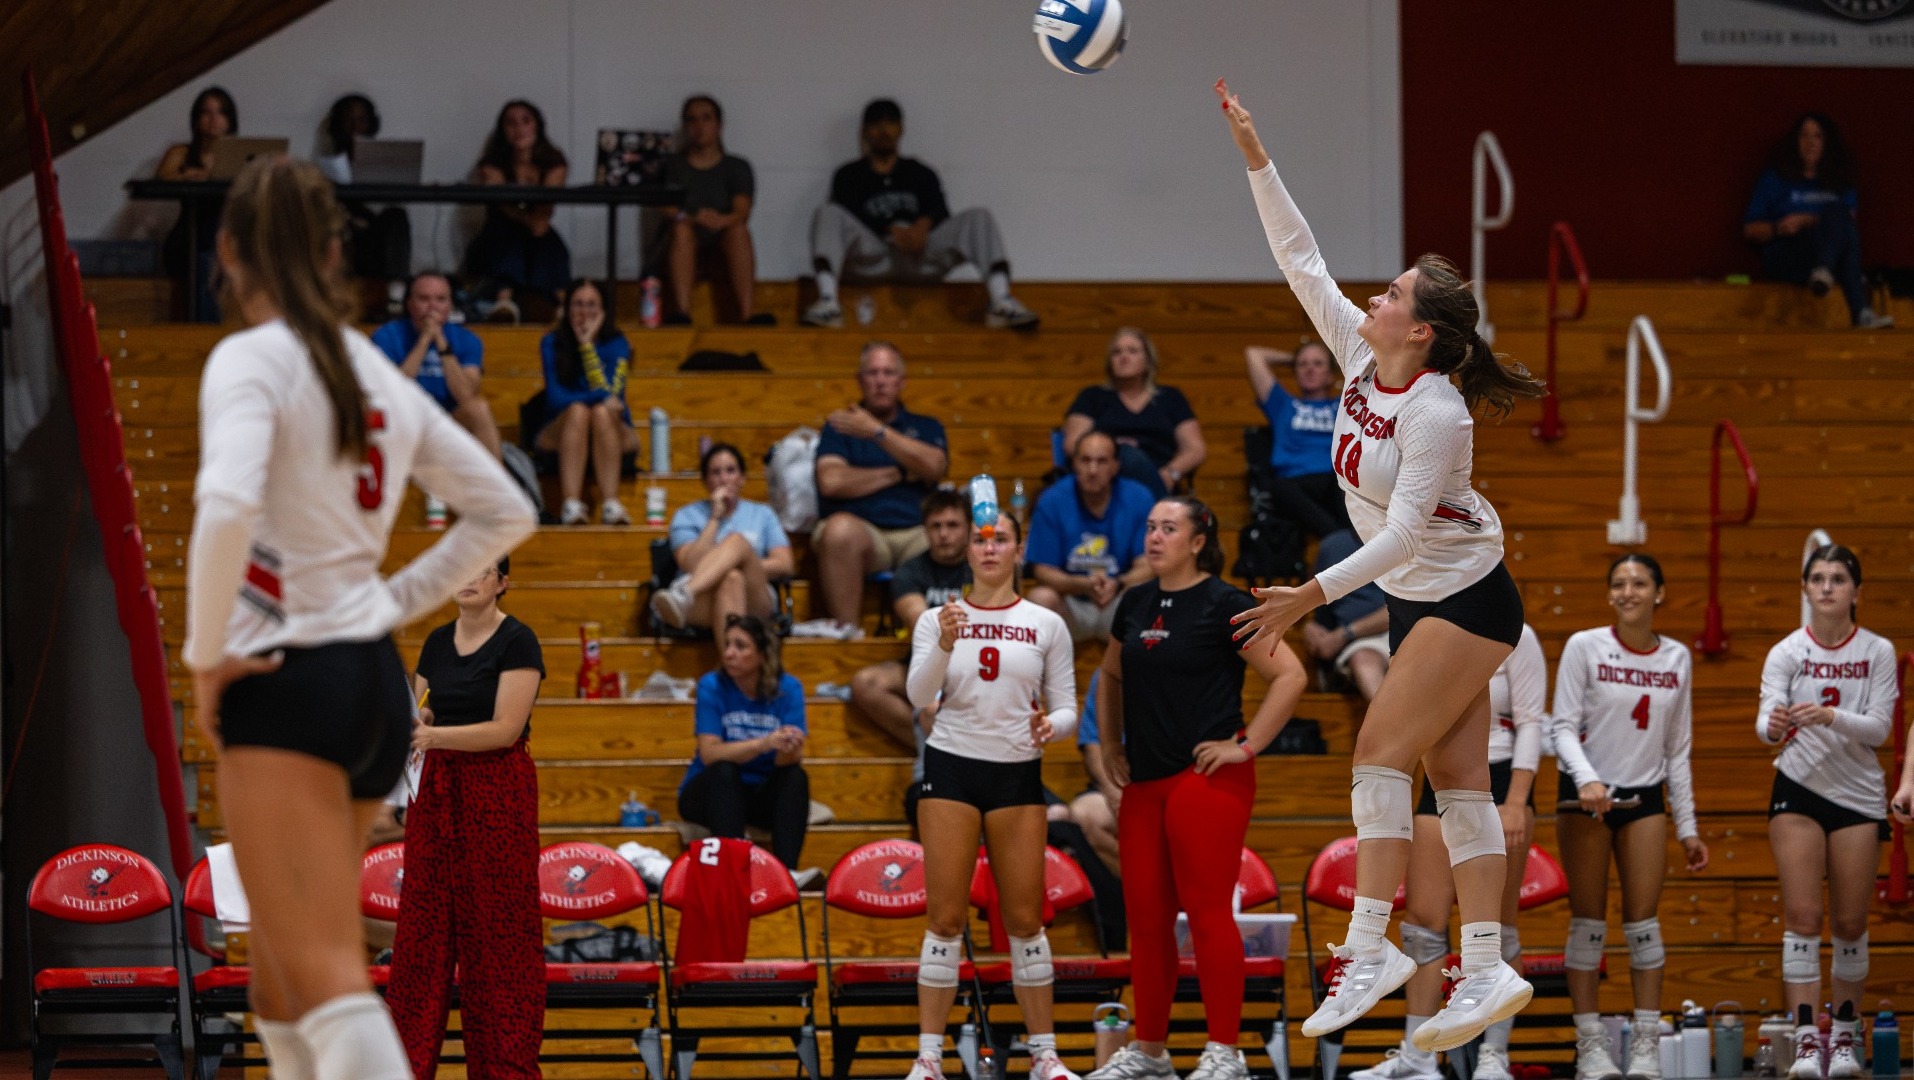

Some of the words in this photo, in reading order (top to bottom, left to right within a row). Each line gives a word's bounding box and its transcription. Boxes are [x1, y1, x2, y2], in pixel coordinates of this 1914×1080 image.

[358, 408, 386, 510] 5
[1334, 433, 1362, 488] 18
[960, 624, 1037, 645] CKINSON
[979, 646, 1000, 682] 9
[1597, 664, 1679, 689] DICKINSON
[1631, 694, 1650, 731] 4
[57, 849, 139, 870] DICKINSON
[700, 837, 721, 866] 2
[850, 846, 924, 867] DICKINSO
[61, 890, 139, 912] ATHLETICS
[540, 888, 616, 910] ATHLETICS
[857, 889, 926, 907] ATHLETIC
